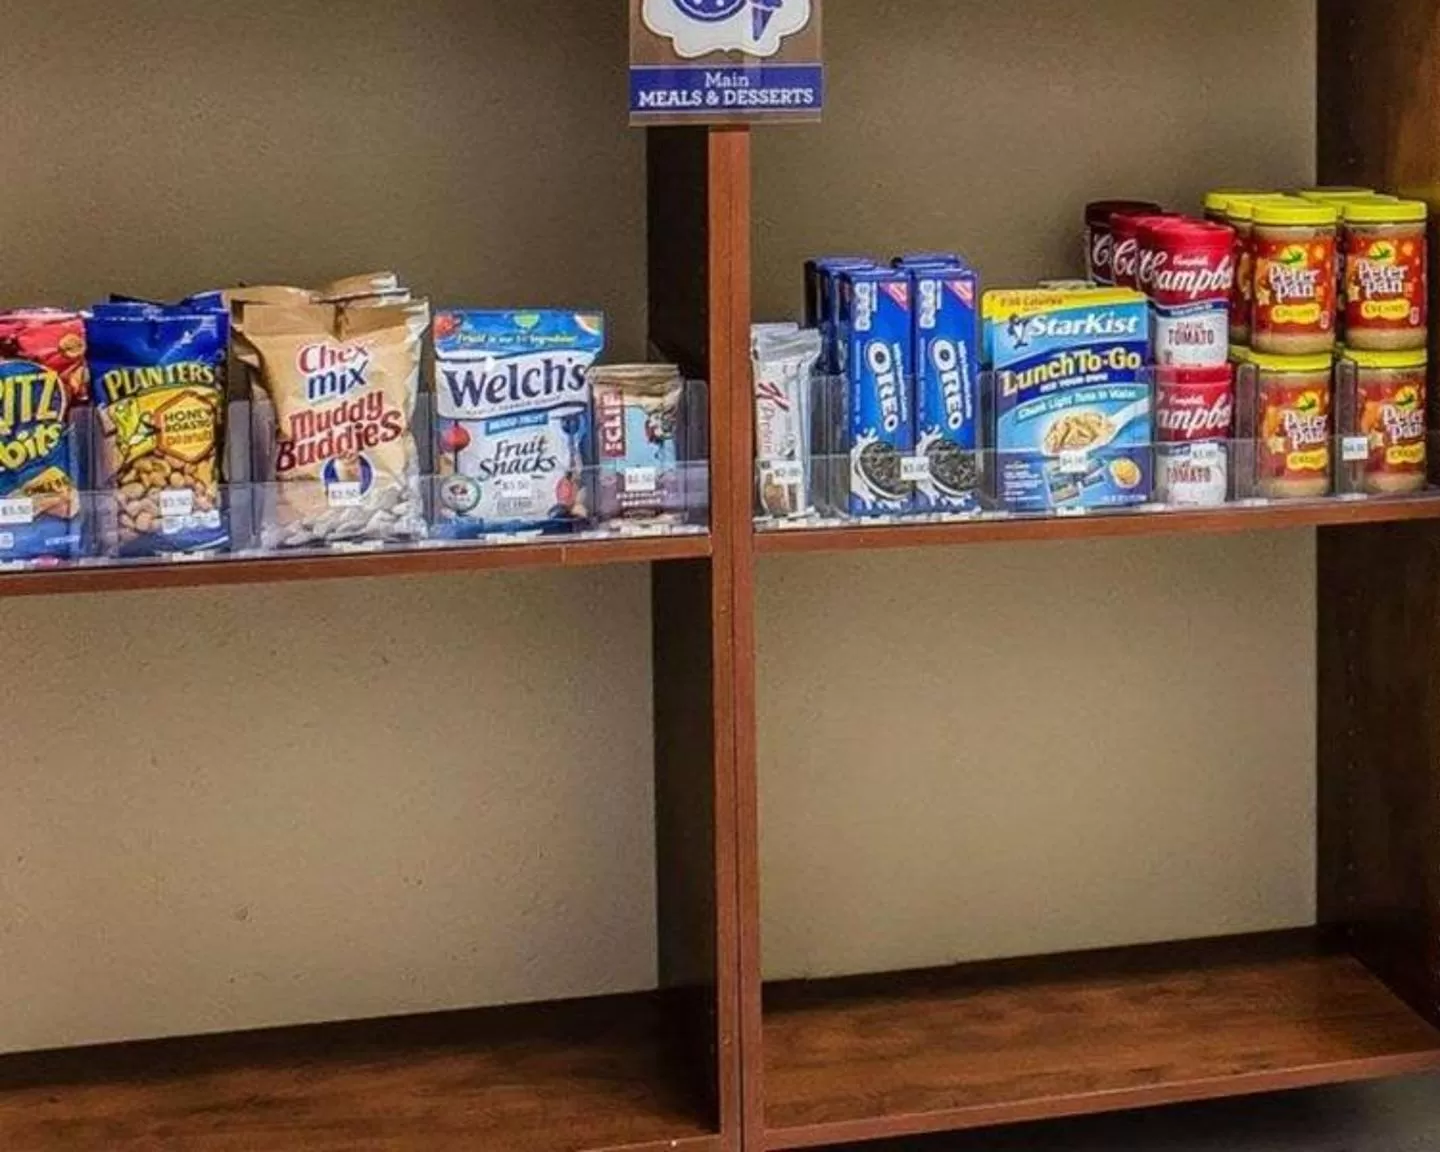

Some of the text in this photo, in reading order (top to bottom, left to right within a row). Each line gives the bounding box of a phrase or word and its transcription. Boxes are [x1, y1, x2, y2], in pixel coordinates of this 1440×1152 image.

[638, 87, 814, 108] MEALS & DESSERTS
[704, 71, 750, 89] Main
[1030, 311, 1141, 336] StarKist
[1168, 329, 1214, 346] TOMATO
[300, 343, 369, 374] Chex
[1003, 351, 1075, 397] Lunch
[104, 362, 215, 399] PLANTERS
[308, 360, 368, 399] mix
[442, 357, 587, 408] Welch's
[867, 341, 899, 433] OREO
[932, 339, 964, 430] OREO
[289, 391, 384, 441] Muddy
[276, 410, 402, 472] Buddies
[494, 435, 549, 461] Fruit
[477, 455, 557, 482] Snacks
